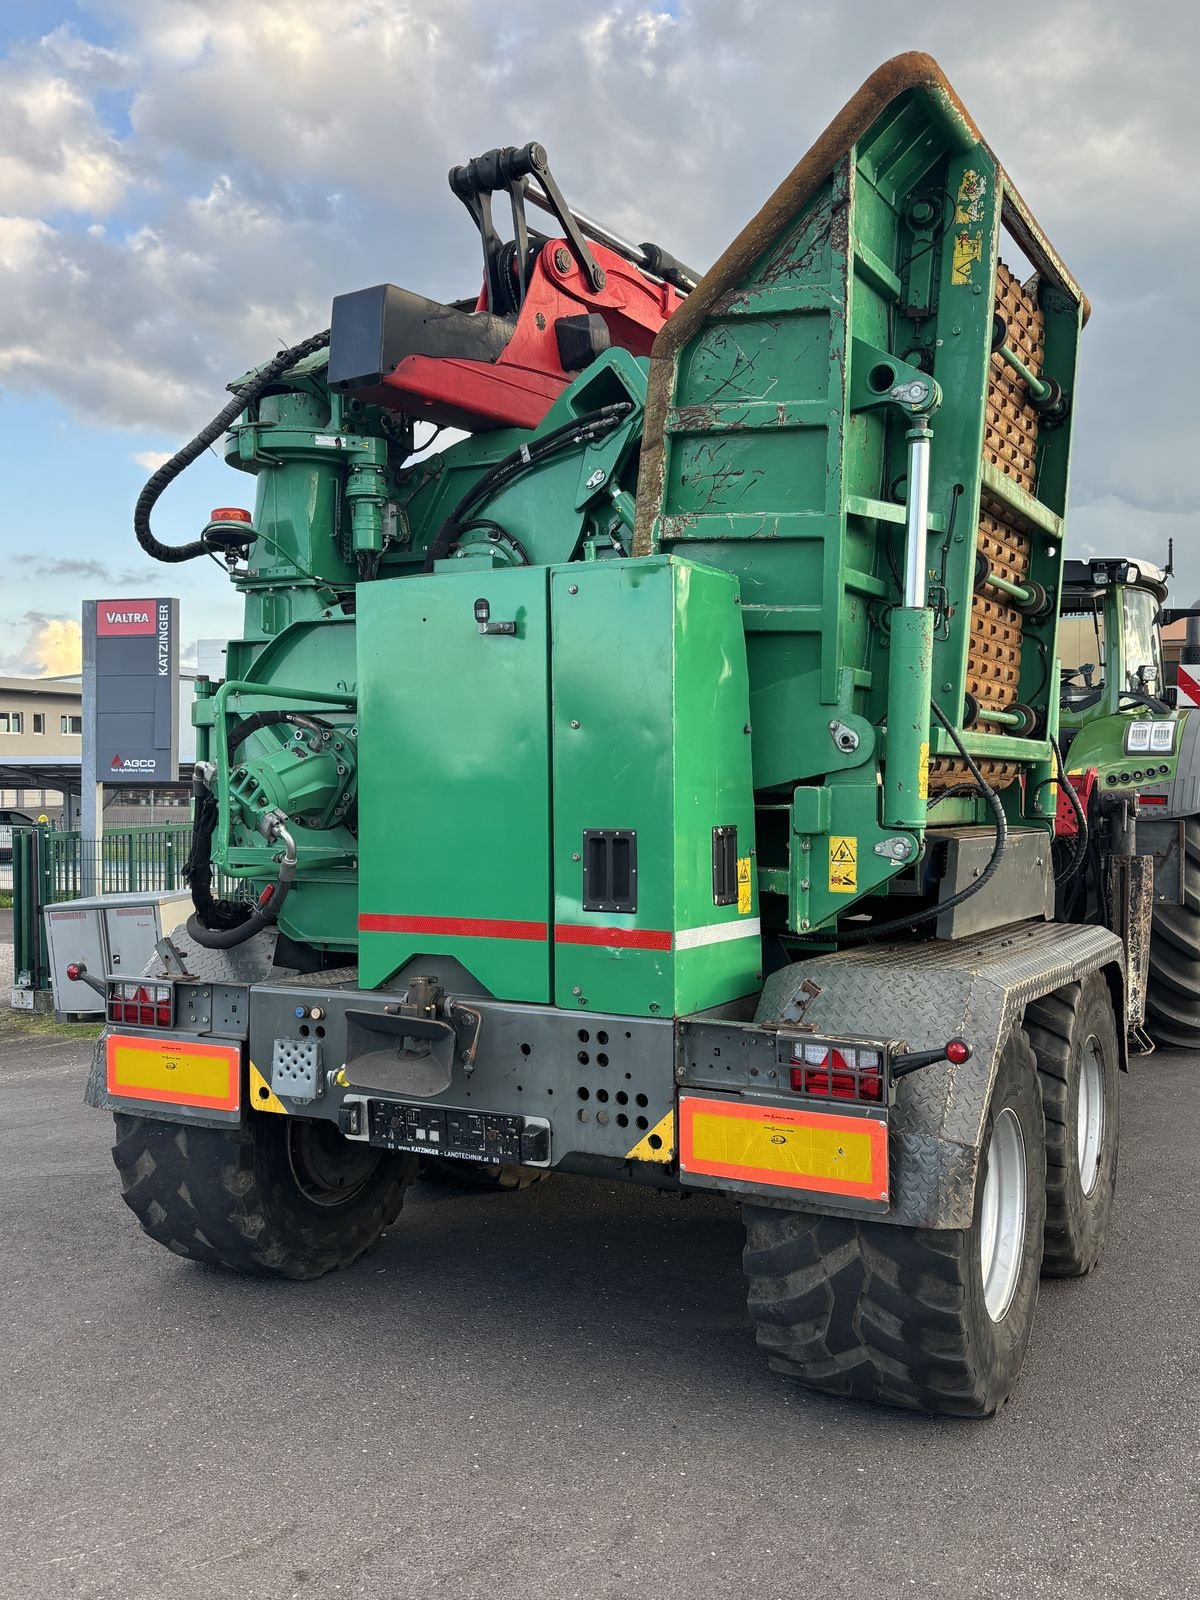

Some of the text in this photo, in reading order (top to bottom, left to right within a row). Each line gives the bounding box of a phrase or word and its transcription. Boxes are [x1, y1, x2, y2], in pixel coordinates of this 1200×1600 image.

[106, 612, 149, 623] VALTRA
[158, 604, 169, 676] KATZINGER
[124, 759, 156, 767] AGCO
